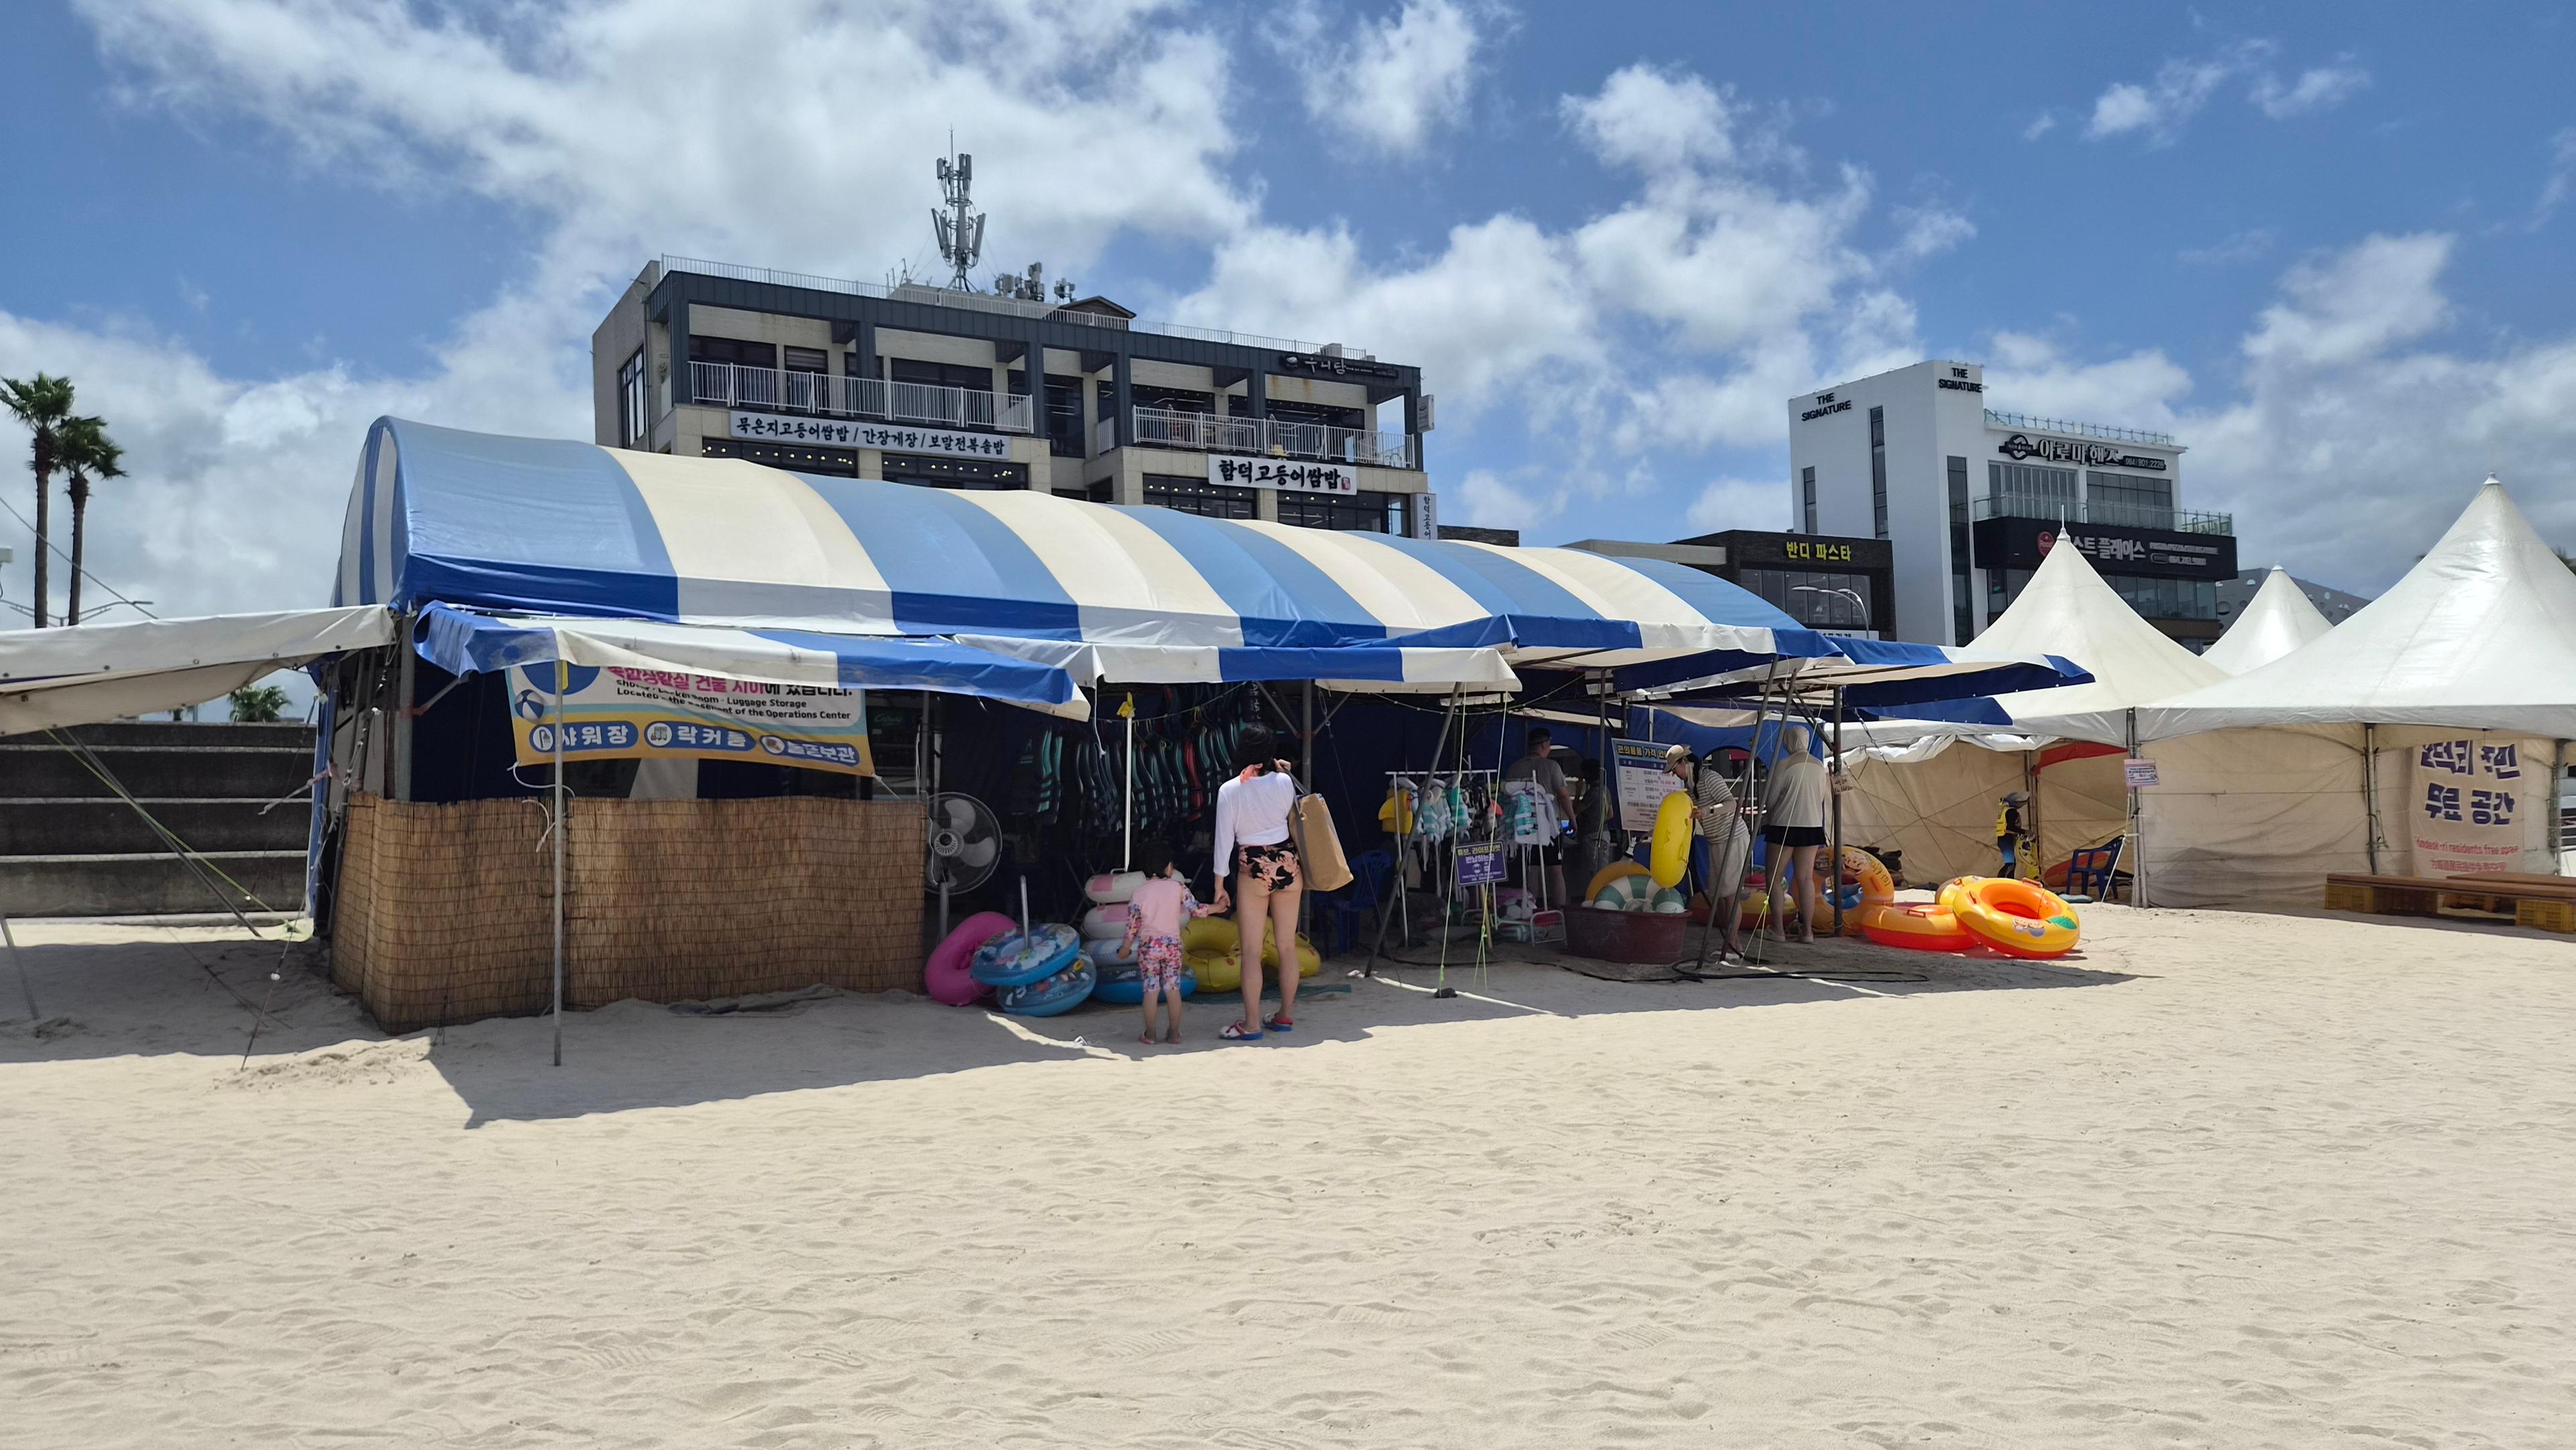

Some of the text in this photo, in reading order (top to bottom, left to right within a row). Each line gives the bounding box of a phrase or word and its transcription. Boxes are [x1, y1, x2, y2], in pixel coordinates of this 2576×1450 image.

[1951, 367, 1968, 378] THE
[1938, 379, 1982, 393] SIGNATURE
[1816, 392, 1835, 405] THE
[1801, 400, 1851, 422] SIGNATURE
[737, 416, 849, 443] 묵은지고등어쌈밥
[862, 427, 918, 448] 간장게장
[928, 435, 1006, 455] 보말전복솥밥
[1786, 541, 1852, 562] 반디 파스타
[727, 697, 767, 708] Luggage
[769, 699, 807, 709] Storage
[735, 707, 745, 716] of
[748, 708, 764, 717] the
[766, 709, 818, 719] Operations
[820, 710, 851, 720] Center
[1644, 746, 1658, 758] 가격
[2425, 782, 2516, 826] 무료 공간
[2449, 842, 2484, 855] residents
[2484, 844, 2500, 856] free
